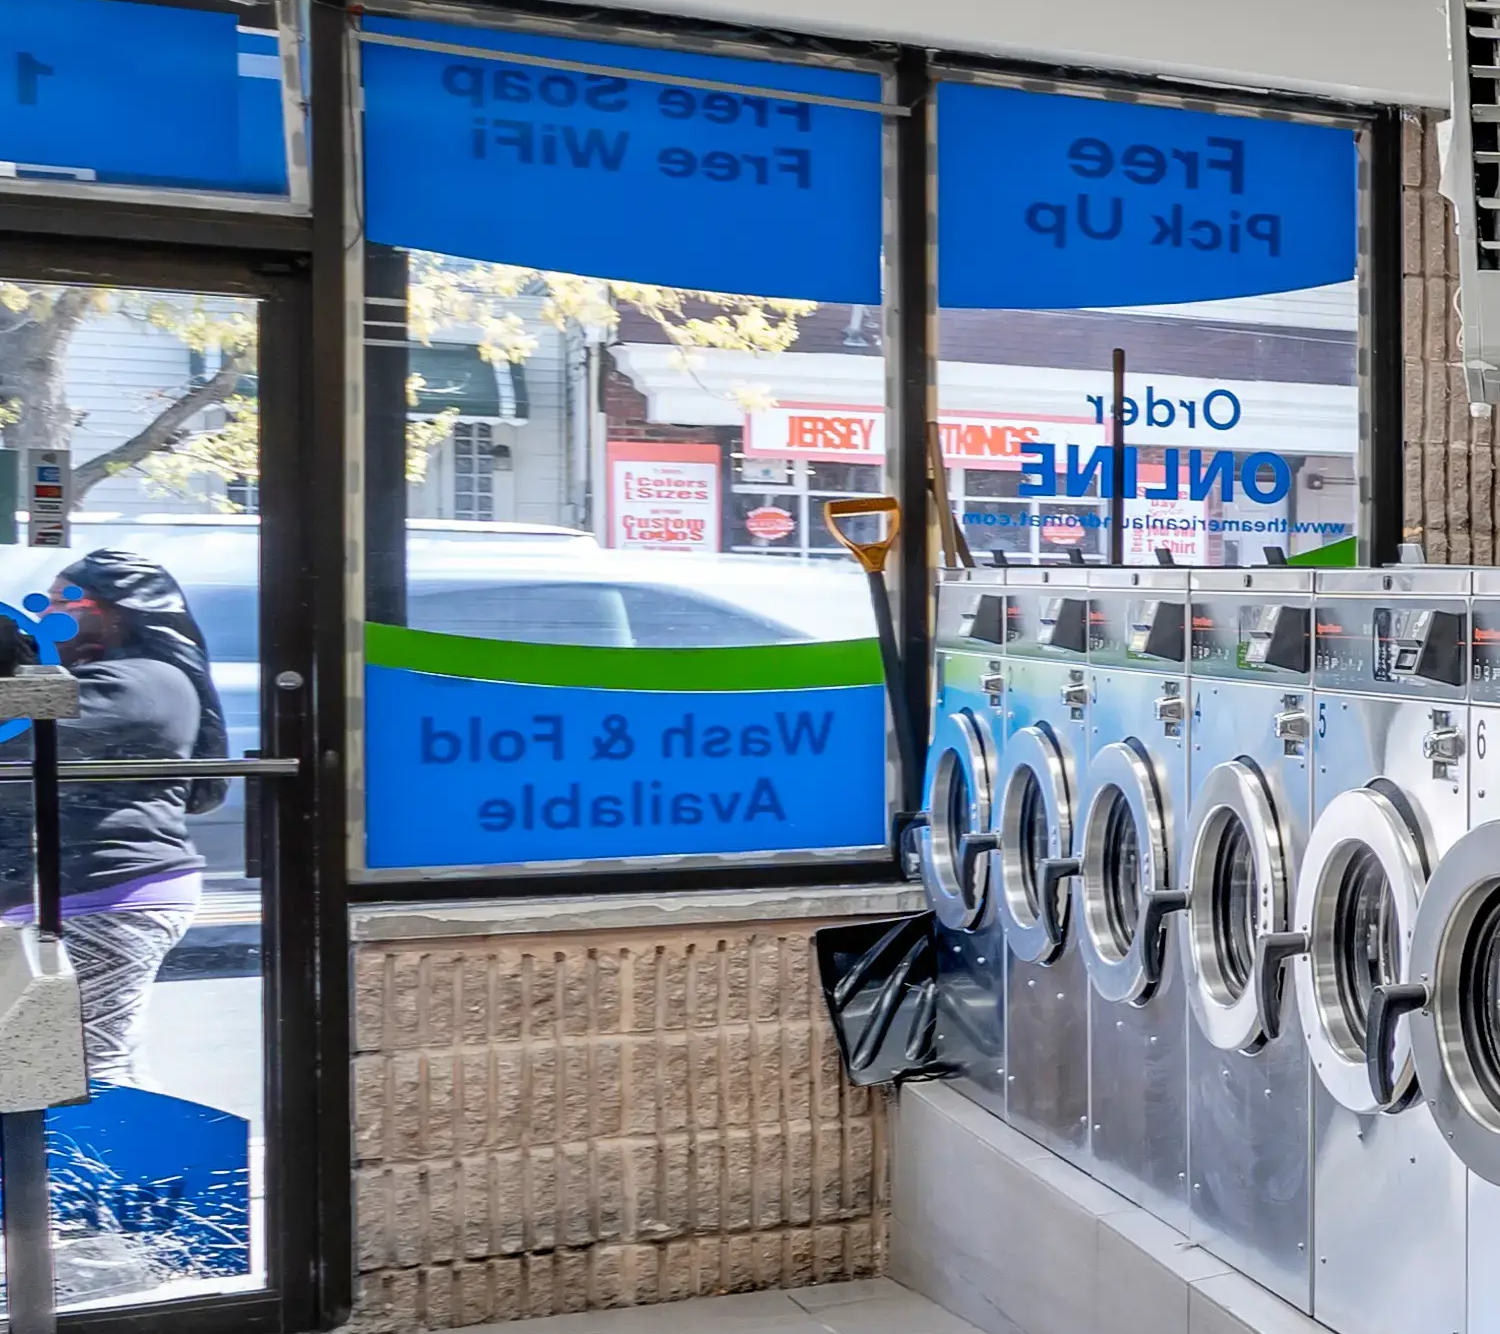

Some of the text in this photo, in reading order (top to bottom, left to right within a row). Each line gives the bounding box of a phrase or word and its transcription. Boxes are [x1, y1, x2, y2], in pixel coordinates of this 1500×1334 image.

[787, 416, 875, 450] JERSEY
[1318, 703, 1326, 739] 5
[1476, 720, 1487, 759] 6
